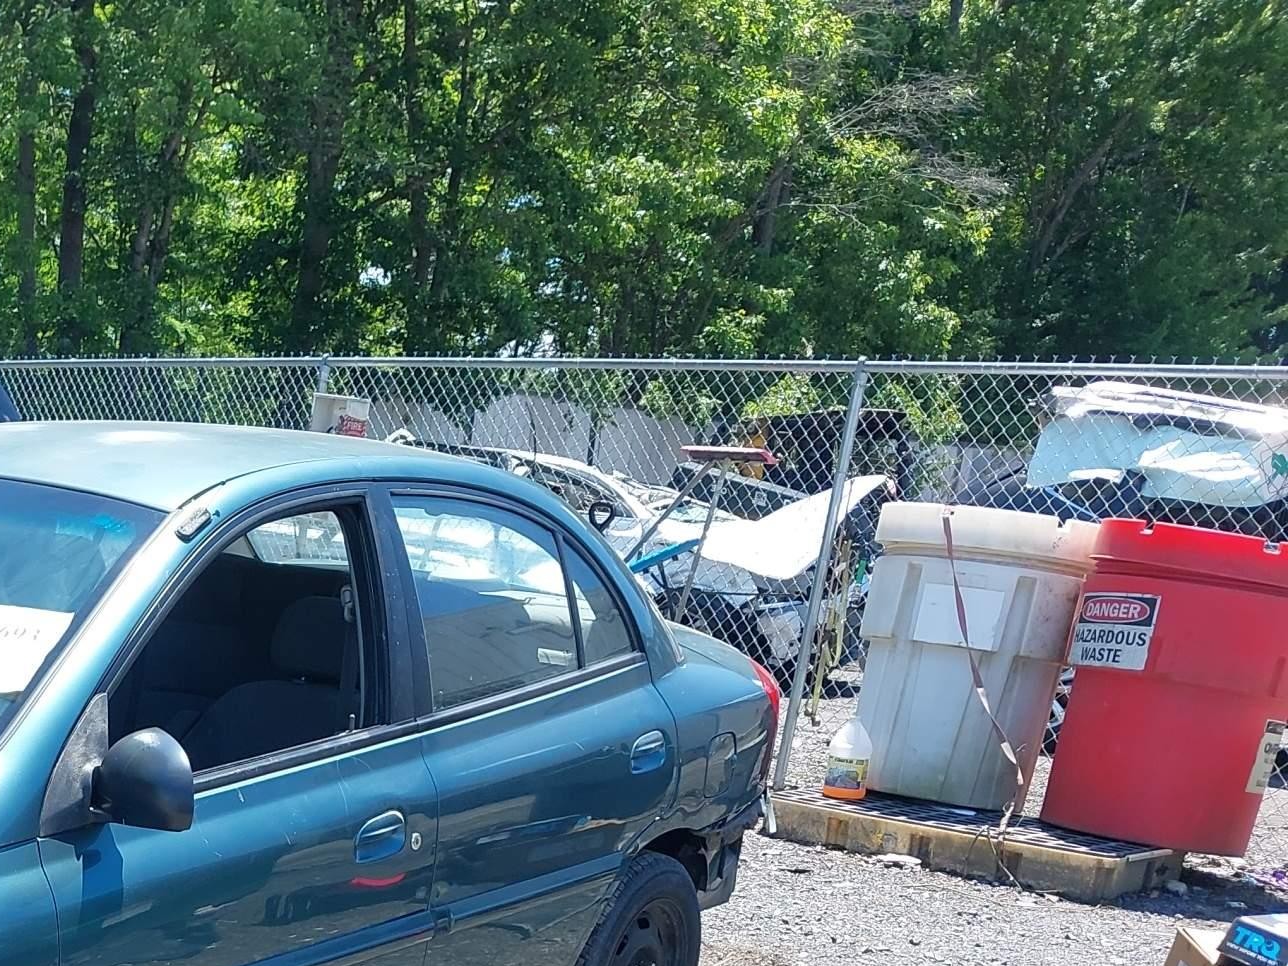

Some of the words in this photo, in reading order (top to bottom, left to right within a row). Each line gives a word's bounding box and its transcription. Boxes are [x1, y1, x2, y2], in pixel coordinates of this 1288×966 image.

[1085, 602, 1141, 618] DANGER
[1074, 628, 1147, 647] HAZARDOUS
[1080, 646, 1122, 663] WASTE
[1233, 926, 1281, 961] TRQ
